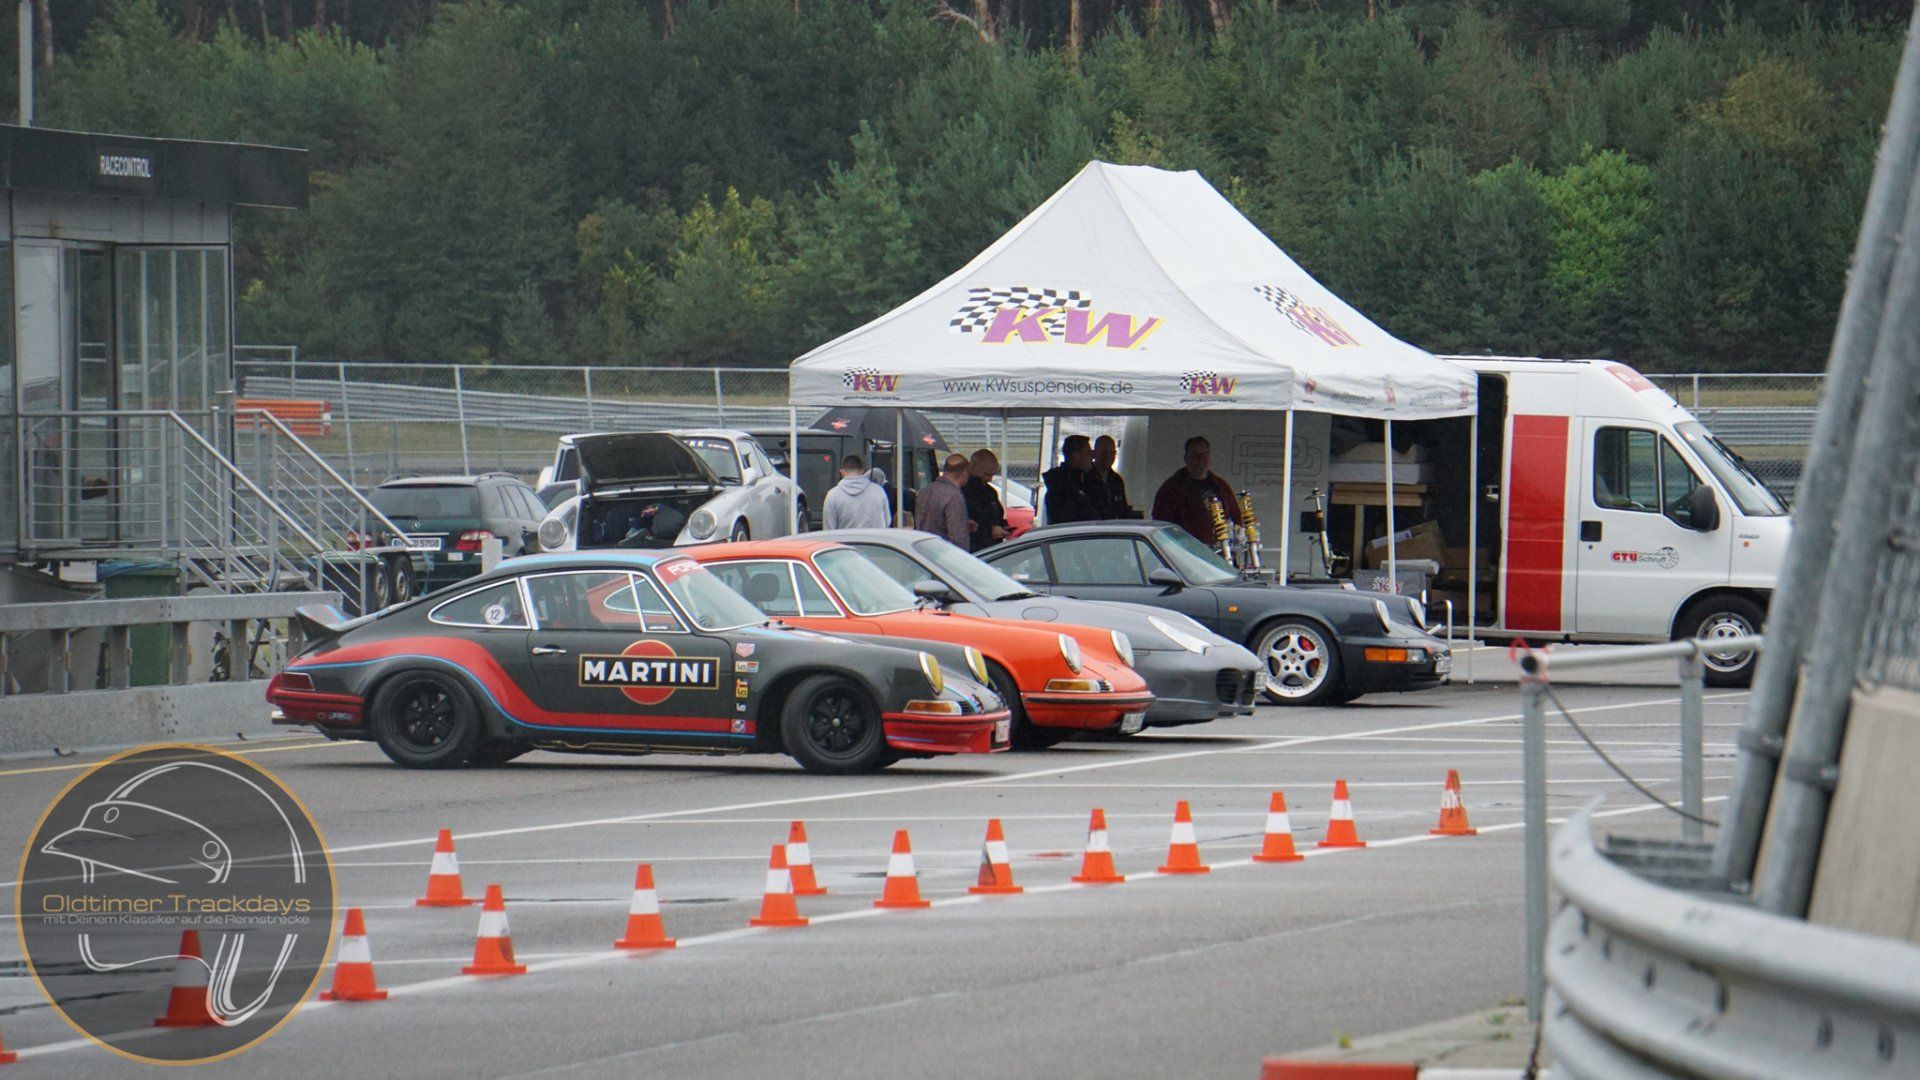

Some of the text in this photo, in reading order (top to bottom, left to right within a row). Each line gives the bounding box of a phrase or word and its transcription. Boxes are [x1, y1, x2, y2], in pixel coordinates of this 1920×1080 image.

[100, 155, 151, 178] RACECONTROL
[981, 307, 1163, 349] KW
[853, 374, 899, 392] KW
[943, 378, 1133, 395] www.KWsuspensions.de
[1189, 376, 1237, 395] KW
[1612, 551, 1638, 562] GTÜ
[584, 660, 710, 684] MARTINI
